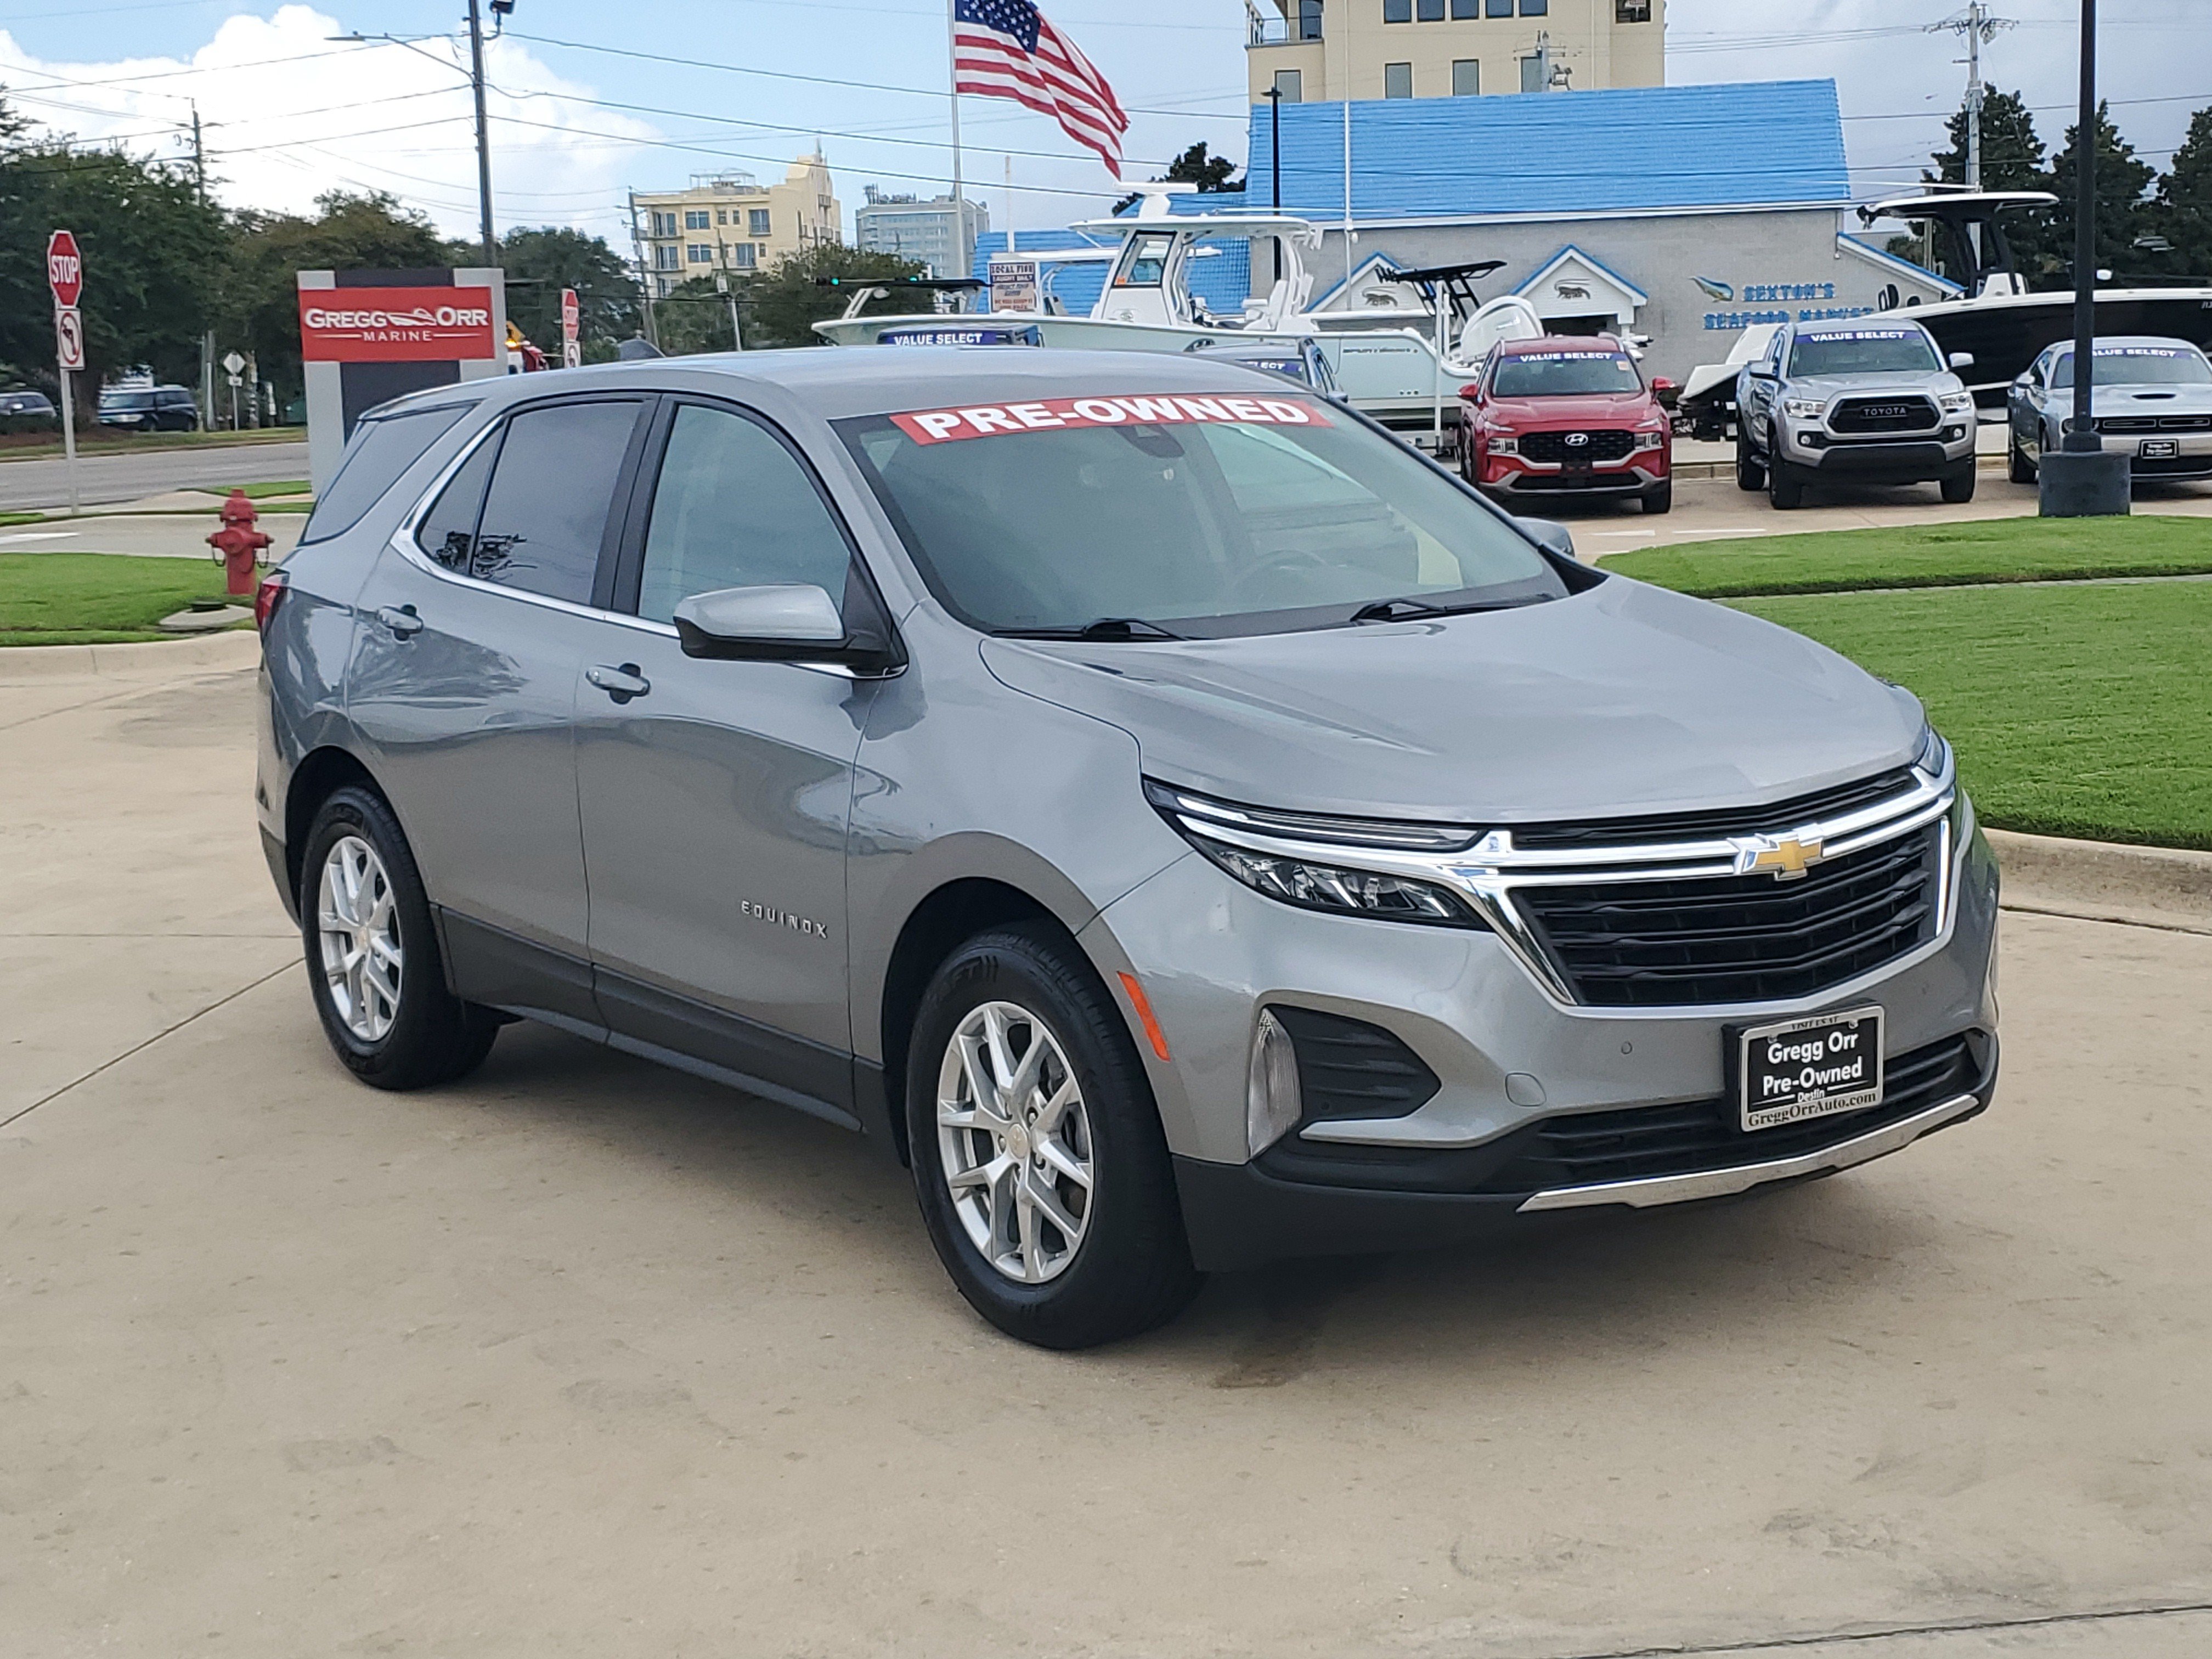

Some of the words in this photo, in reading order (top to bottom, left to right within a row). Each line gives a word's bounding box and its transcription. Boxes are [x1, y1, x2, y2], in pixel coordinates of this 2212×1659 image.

[52, 255, 78, 284] STOP
[1743, 283, 1836, 301] SEXTON'S
[305, 307, 388, 329] GREGG
[436, 306, 489, 326] ORR
[362, 331, 432, 341] MARINE
[894, 334, 933, 346] VALUE
[936, 333, 983, 345] SELECT
[1811, 332, 1854, 342] VALUE
[1520, 353, 1561, 362] VALUE
[2126, 349, 2176, 357] SELECT
[912, 398, 1310, 439] PRE-OWNED
[1864, 407, 1906, 416] TOYOTA
[741, 900, 827, 939] EQUINOX
[1768, 1041, 1823, 1064] Gregg
[1828, 1031, 1859, 1052] Orr
[1763, 1056, 1863, 1096] Pre-Owned
[1748, 1093, 1876, 1126] GreggOrrAuto.com
